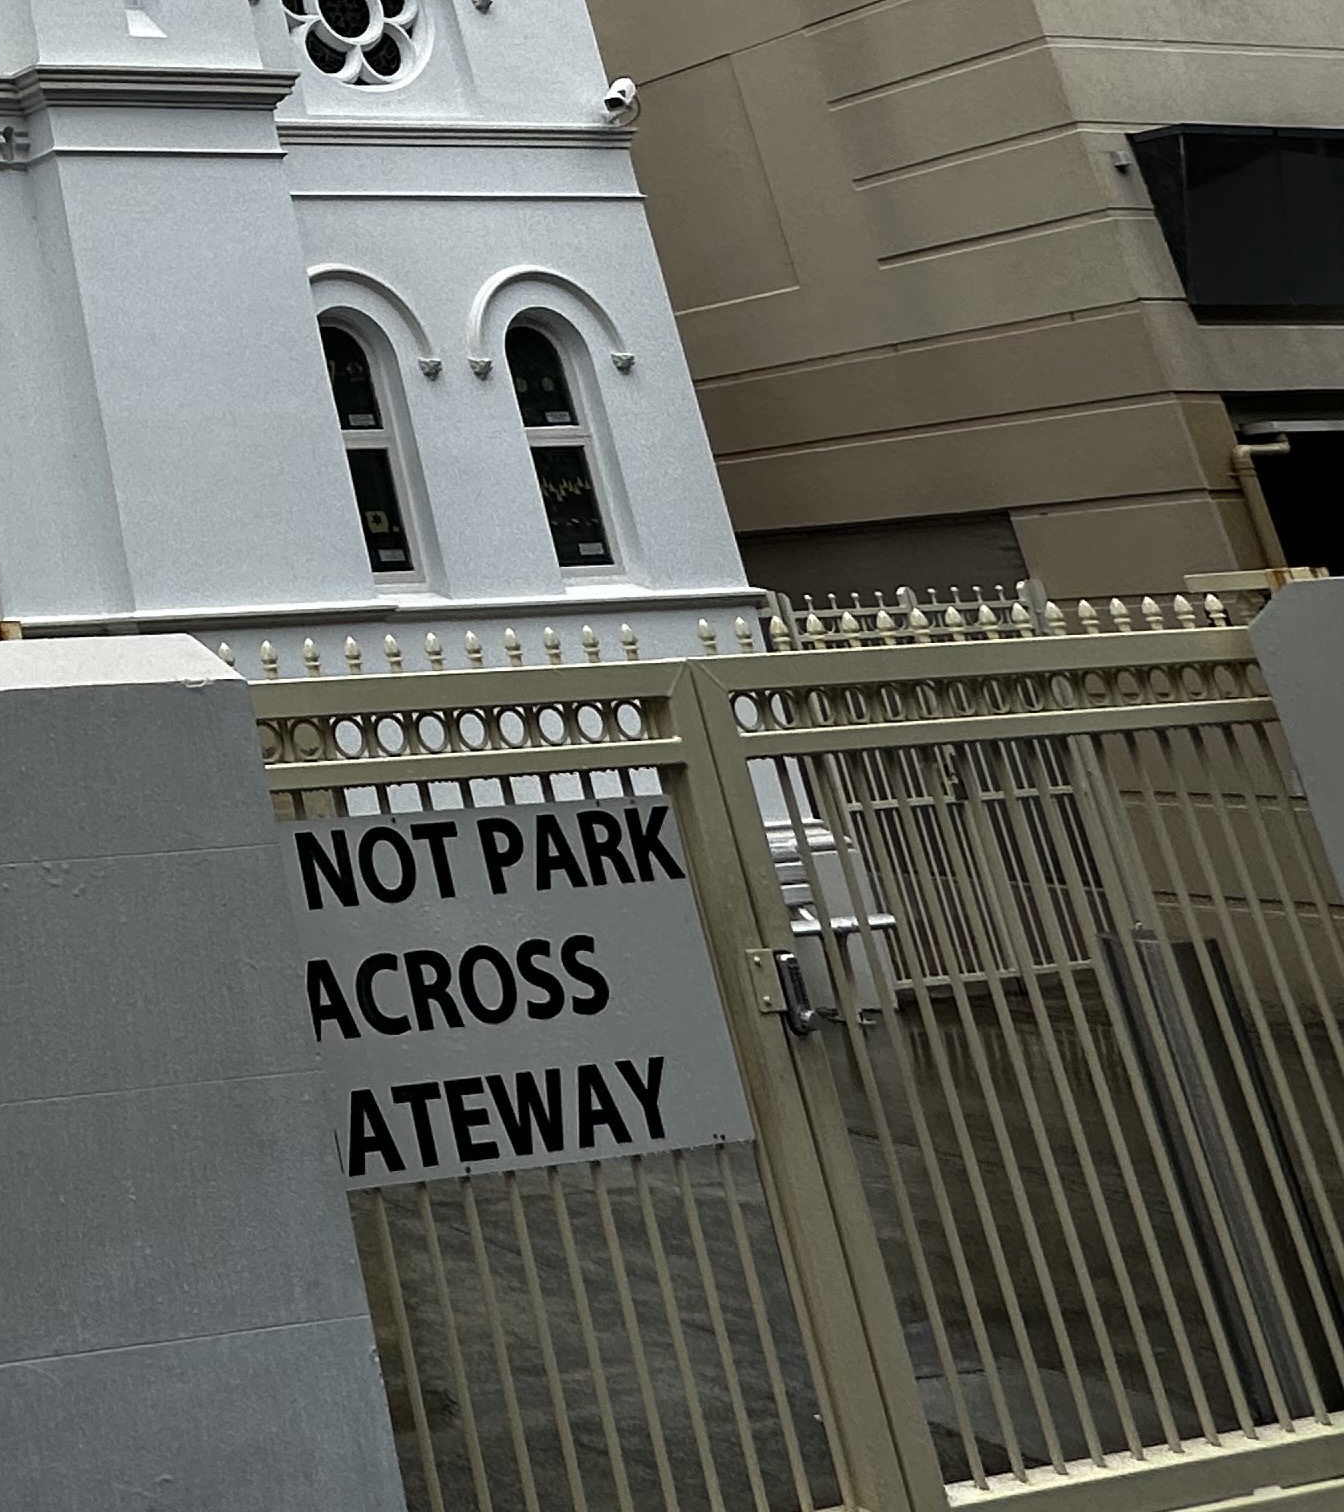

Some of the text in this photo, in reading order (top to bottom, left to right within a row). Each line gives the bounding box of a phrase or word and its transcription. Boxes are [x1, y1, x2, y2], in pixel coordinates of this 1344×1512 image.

[294, 805, 687, 911] NOT PARK
[305, 934, 611, 1043] ACROSS
[334, 1055, 666, 1178] ATEWAY
